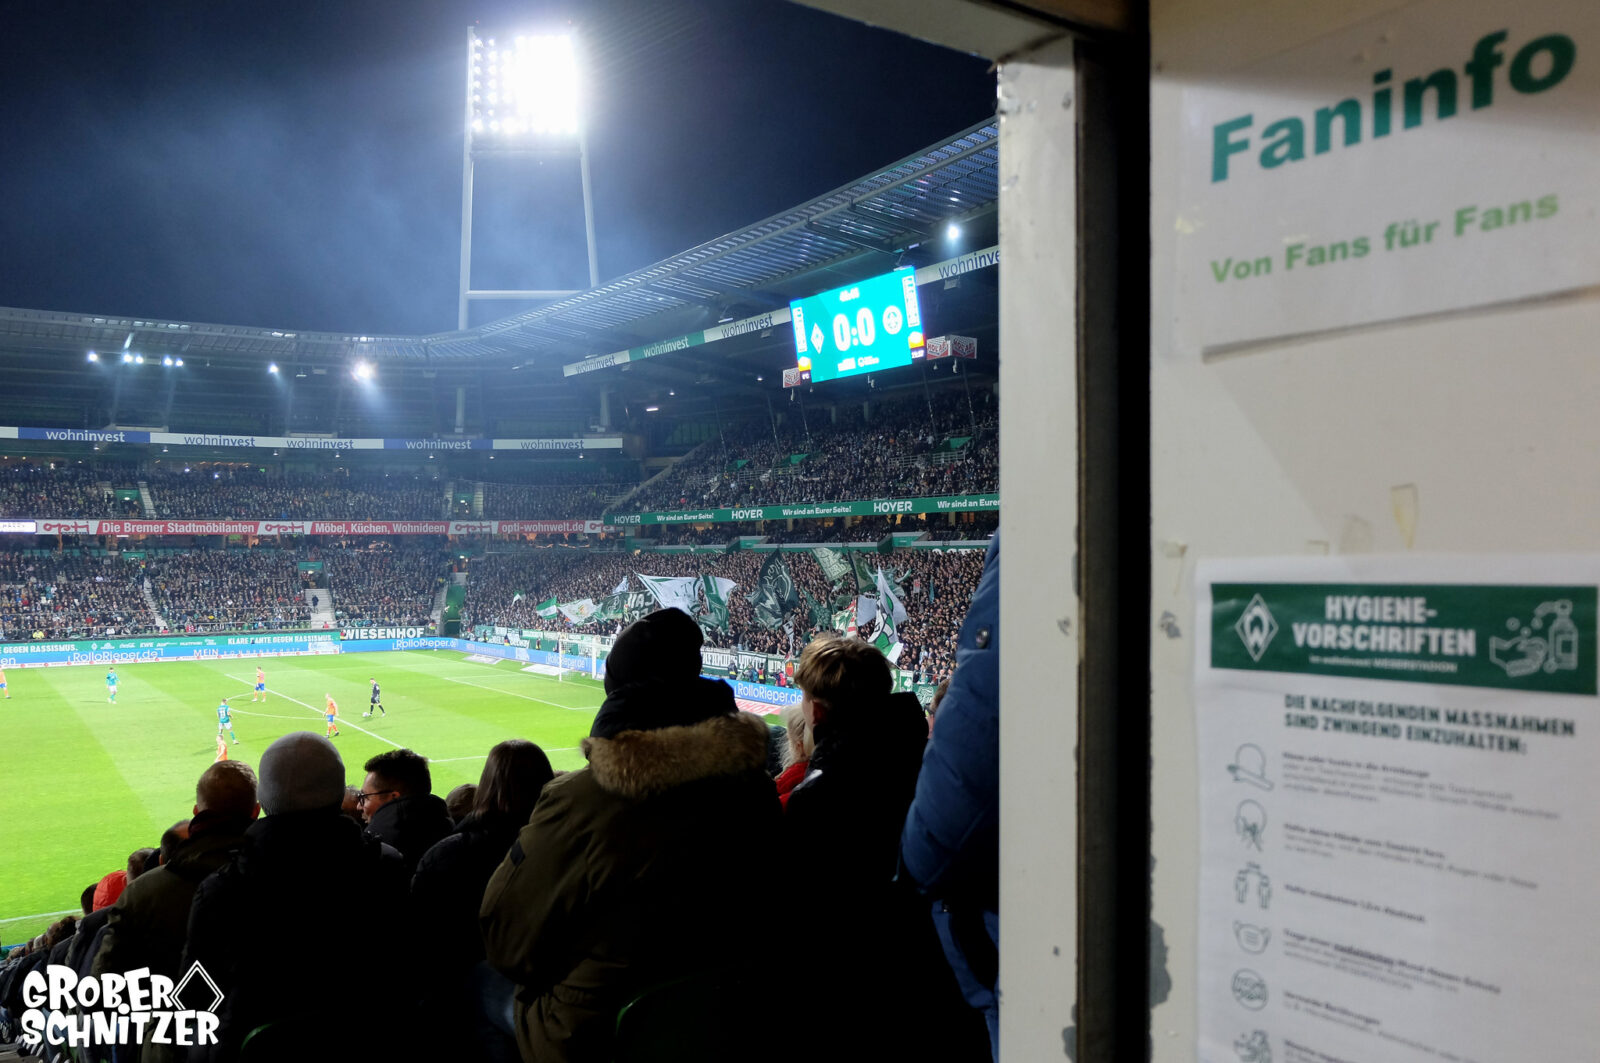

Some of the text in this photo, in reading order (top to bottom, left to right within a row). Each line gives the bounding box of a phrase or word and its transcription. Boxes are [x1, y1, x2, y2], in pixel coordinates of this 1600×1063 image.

[1211, 28, 1577, 184] Faninfo
[1210, 193, 1560, 283] Von Fans für Fans
[721, 312, 774, 339] wohninvest
[833, 306, 876, 352] 0:0
[643, 335, 690, 358] wohninvest
[575, 353, 616, 374] wohninvest
[46, 429, 125, 442] wohninvest
[184, 434, 256, 448] wohninvest
[286, 438, 355, 449] wohninvest
[406, 439, 472, 450] wohninvest
[520, 438, 585, 450] wohninvest
[782, 508, 793, 516] Wir
[793, 507, 807, 515] sind
[815, 507, 832, 515] Eurer
[832, 505, 852, 513] Seite!
[873, 500, 913, 513] HOYER
[937, 501, 951, 509] Wir
[951, 499, 968, 508] sind
[614, 515, 641, 524] HOYER
[656, 514, 666, 522] Wir
[731, 509, 763, 519] HOYER
[43, 521, 90, 535] opti
[102, 522, 255, 534] Die Bremer Stadtmöbilanten
[264, 521, 305, 535] opti
[315, 521, 446, 534] Möbel, Küchen, Wohnideen
[501, 521, 585, 534] opti-wohnwelt.de
[1324, 595, 1438, 624] HYGIENE-
[228, 637, 249, 645] KLARE
[272, 635, 294, 643] GEGEN
[294, 634, 334, 643] RASSISMUS.
[344, 627, 425, 640] WIESENHOF
[1292, 622, 1476, 656] VORSCHRIFTEN
[3, 643, 78, 654] GEGEN RASSISMUS.
[396, 638, 457, 650] RolloRieper.de
[72, 649, 159, 662] RolloRieper.de
[193, 648, 219, 657] MEIN
[737, 682, 802, 705] RolloRieper.de
[1285, 693, 1576, 737] DIE NACHFOLGENDEN MASSNAHMEN
[1284, 713, 1528, 755] SIND ZWINGEND EINZUHALTEN:
